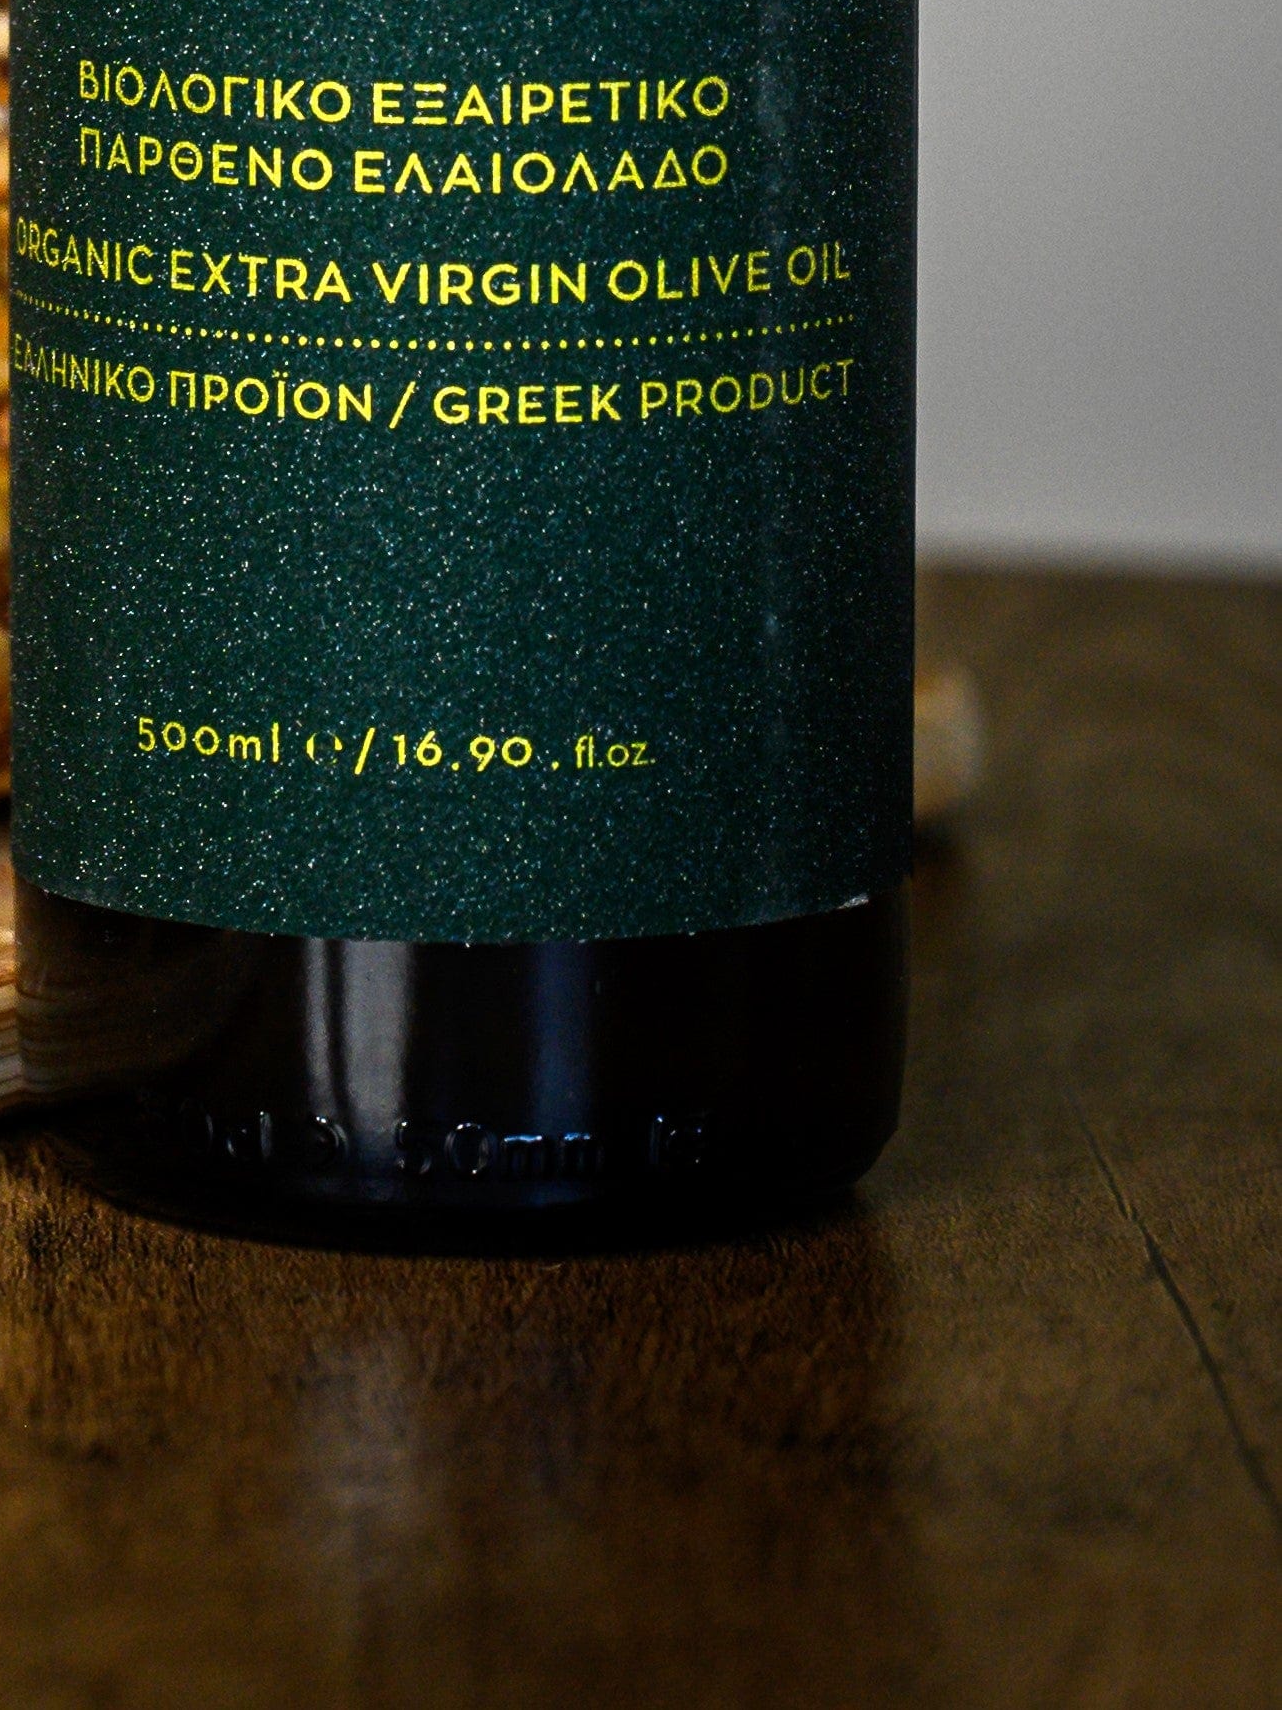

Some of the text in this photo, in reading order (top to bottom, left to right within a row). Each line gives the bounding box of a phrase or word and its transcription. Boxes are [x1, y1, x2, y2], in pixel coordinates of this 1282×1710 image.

[16, 215, 851, 307] ORGANIC EXTRA VIRGIN OLIVE OIL
[432, 383, 622, 426] GREEK
[640, 358, 853, 420] PRODUCT
[137, 716, 280, 763] 500ml
